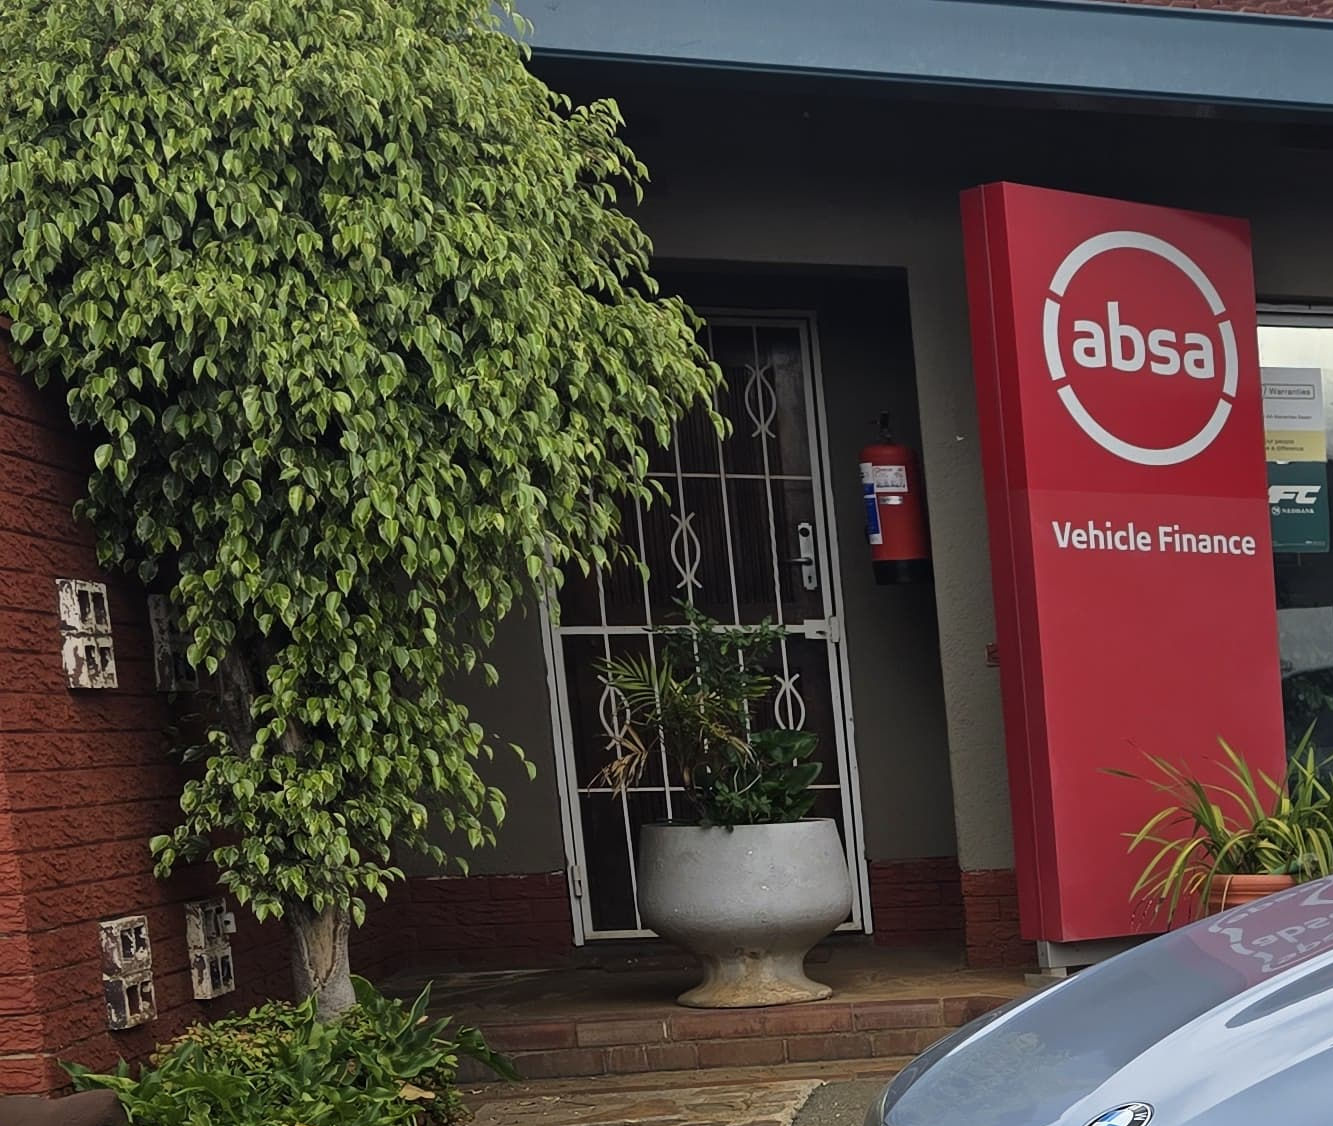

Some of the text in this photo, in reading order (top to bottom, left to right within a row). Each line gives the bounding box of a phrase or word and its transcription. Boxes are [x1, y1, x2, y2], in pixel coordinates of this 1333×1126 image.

[1073, 301, 1215, 379] absa
[1052, 520, 1256, 555] Vehicle Finance
